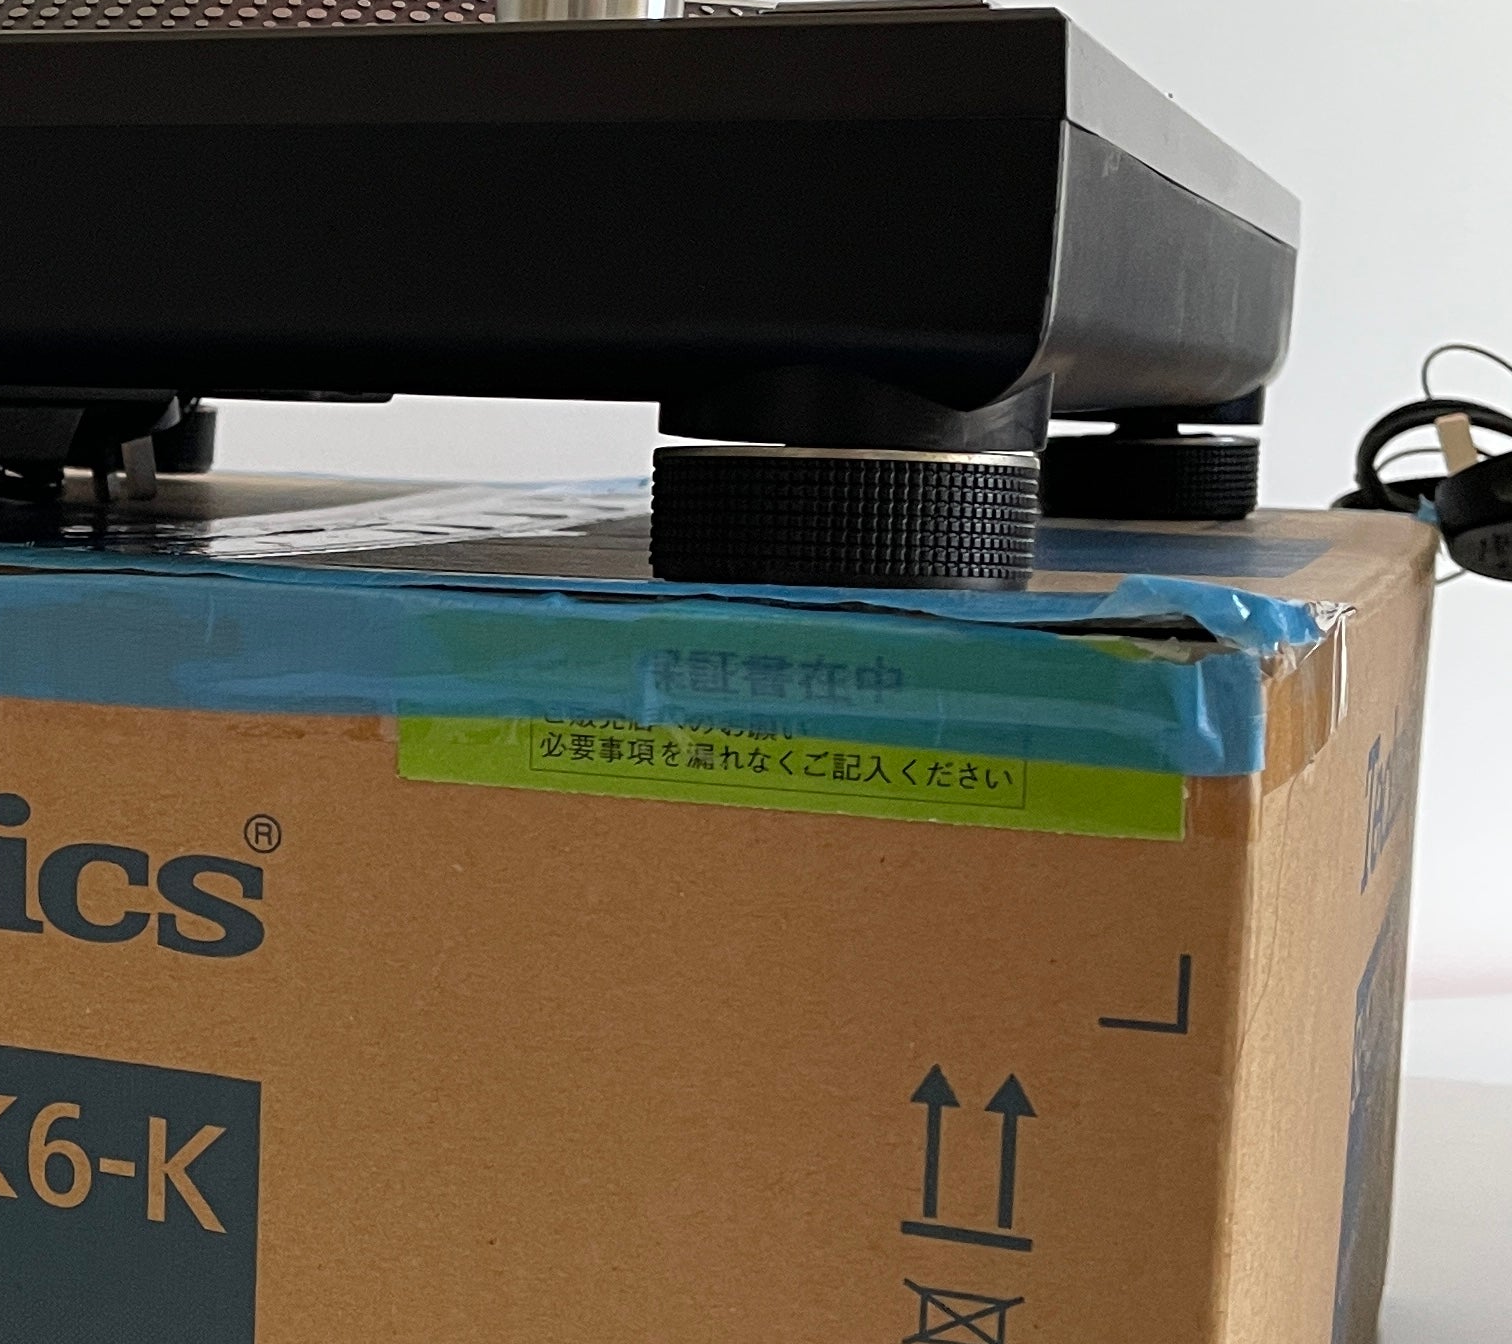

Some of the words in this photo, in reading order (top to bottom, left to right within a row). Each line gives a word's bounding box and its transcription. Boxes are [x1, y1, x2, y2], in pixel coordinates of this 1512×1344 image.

[539, 731, 1014, 792] 必要事項を漏れなくご記入ください
